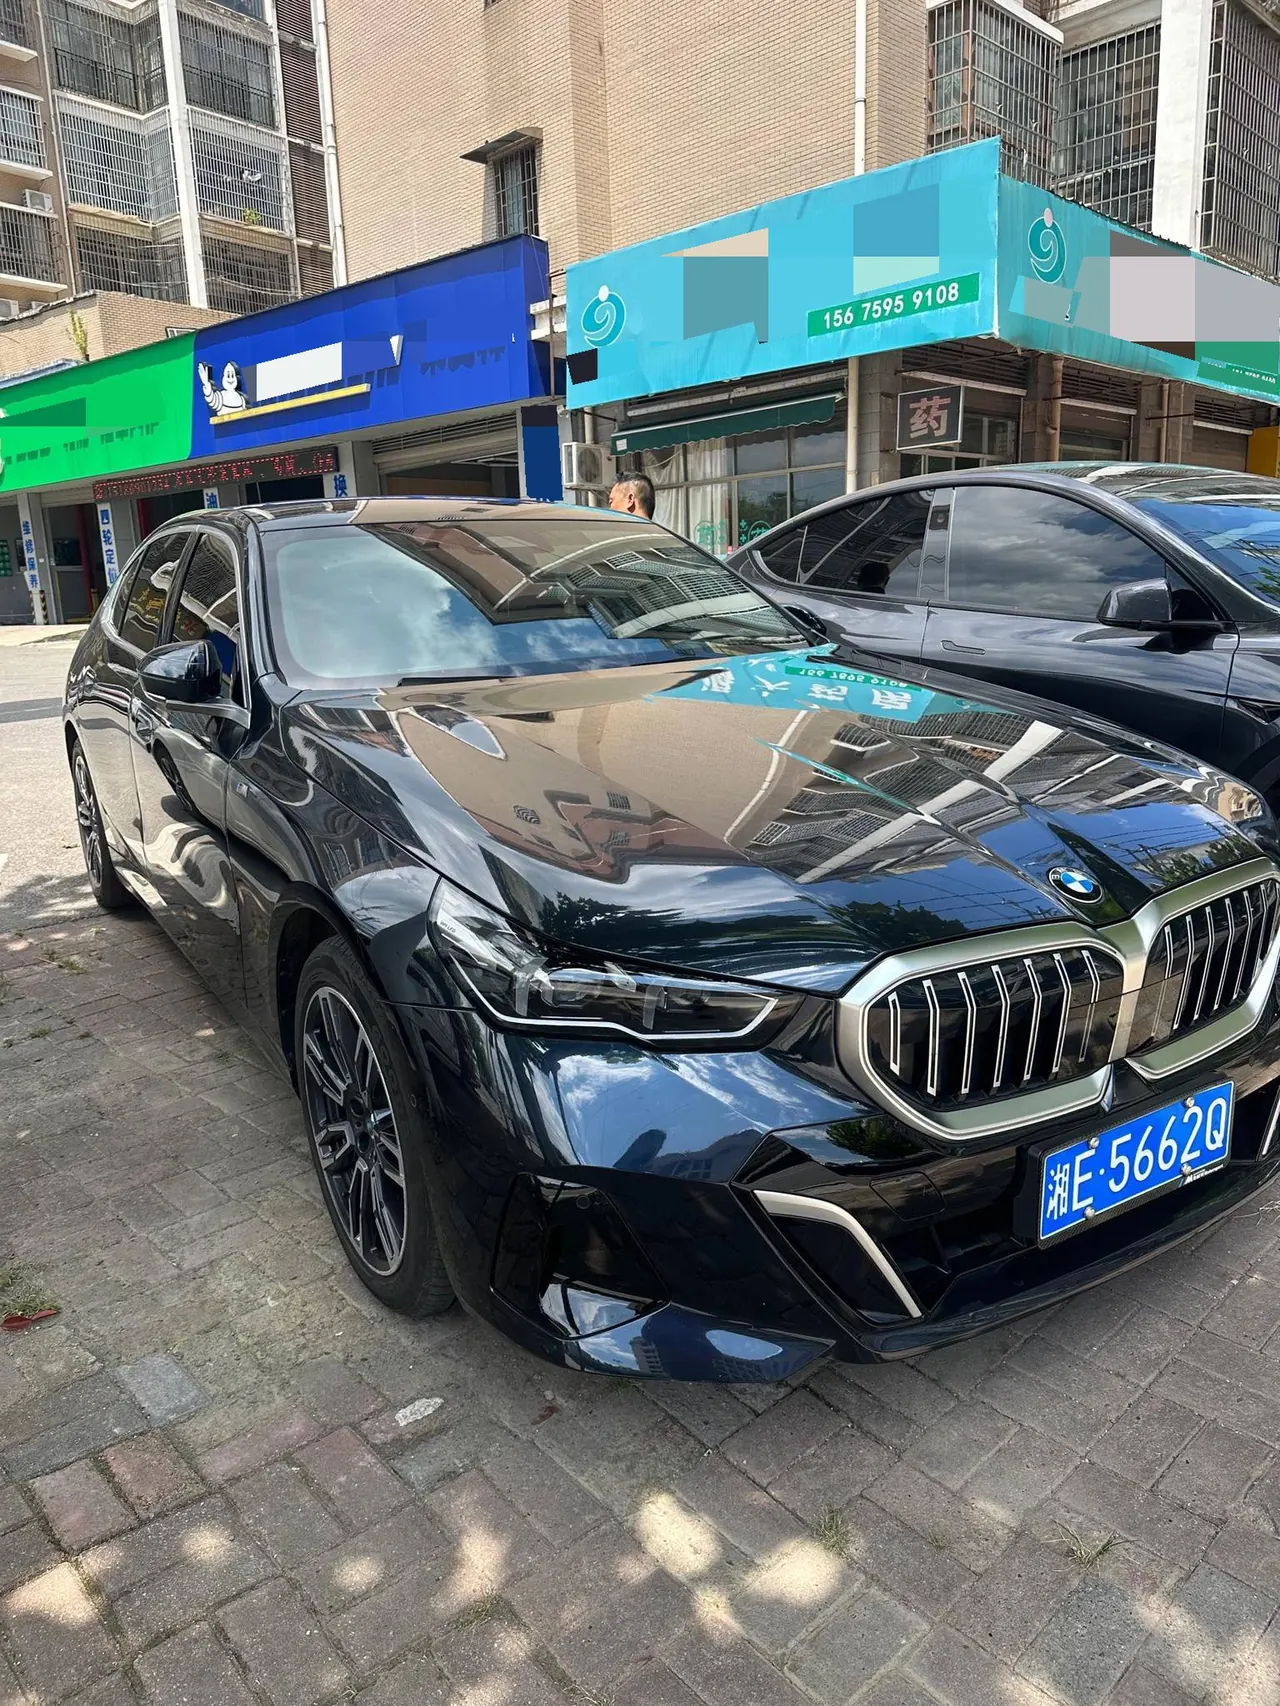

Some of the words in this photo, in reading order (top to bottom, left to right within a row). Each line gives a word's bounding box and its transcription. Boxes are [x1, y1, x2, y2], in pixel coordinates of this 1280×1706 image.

[824, 306, 853, 329] 156
[861, 294, 904, 321] 7595
[912, 282, 959, 310] 9108
[909, 395, 952, 439] 药
[1046, 1097, 1227, 1220] 湘E·5662Q
